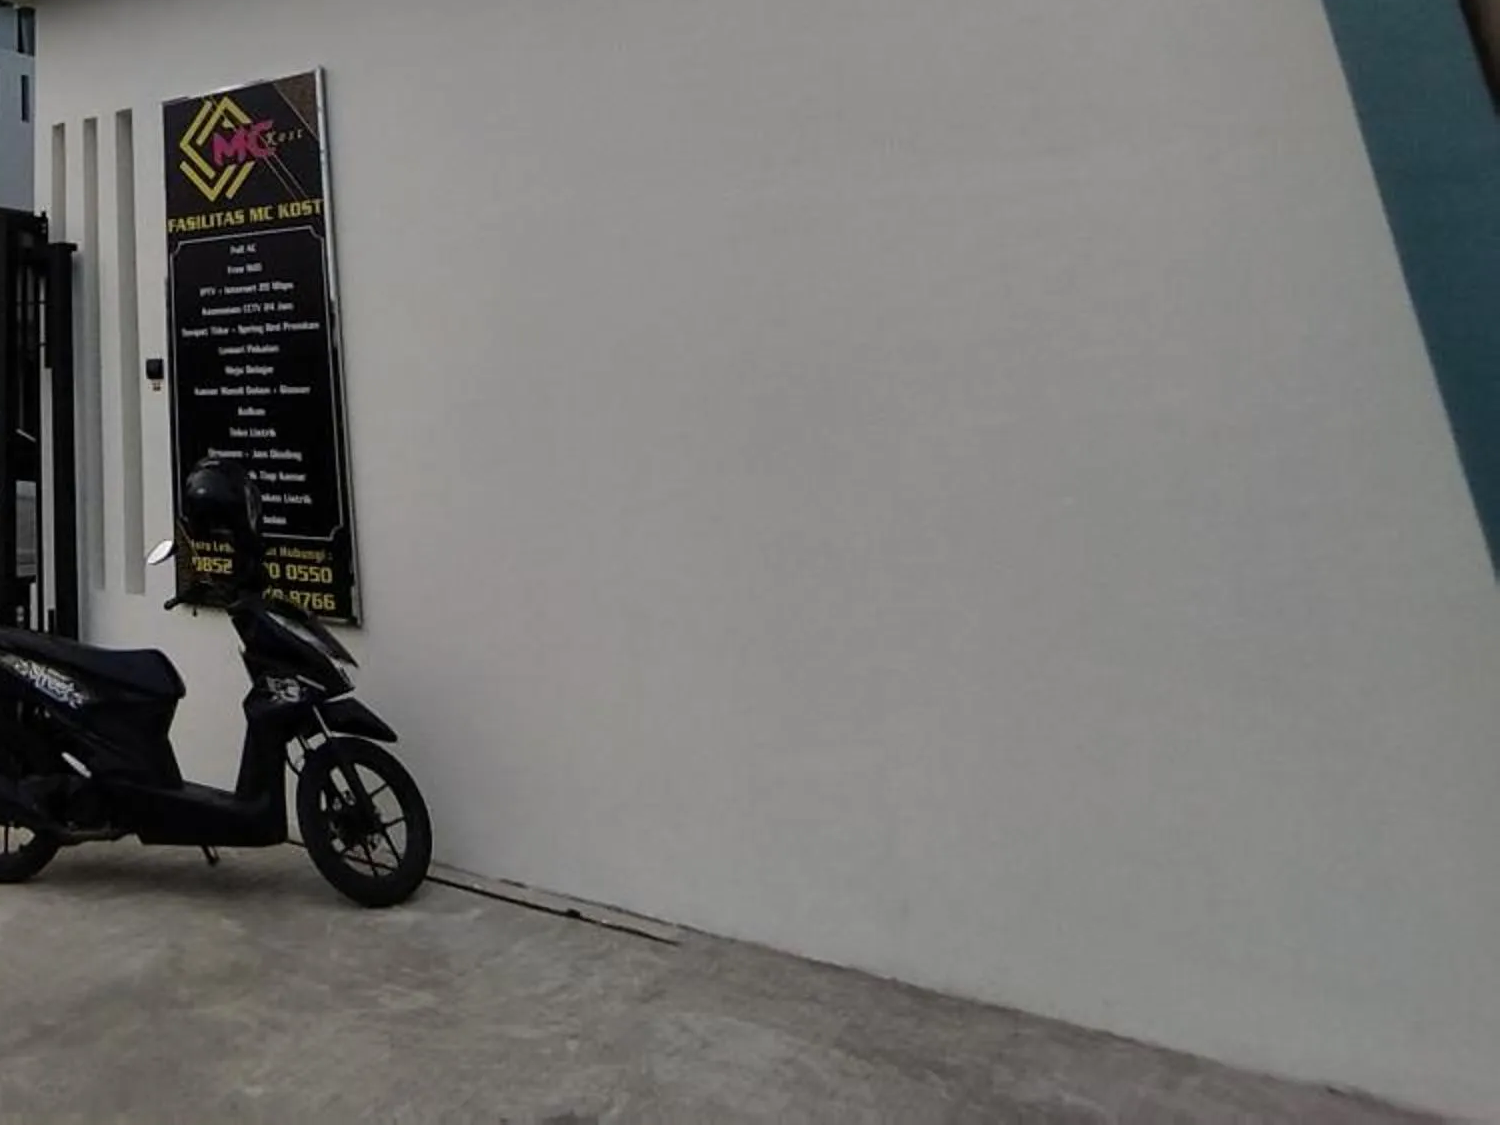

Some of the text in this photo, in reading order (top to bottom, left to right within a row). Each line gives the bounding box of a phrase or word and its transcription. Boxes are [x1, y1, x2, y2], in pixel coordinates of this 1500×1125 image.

[168, 198, 324, 234] FASILITAS MC KOST
[285, 563, 334, 584] 0550
